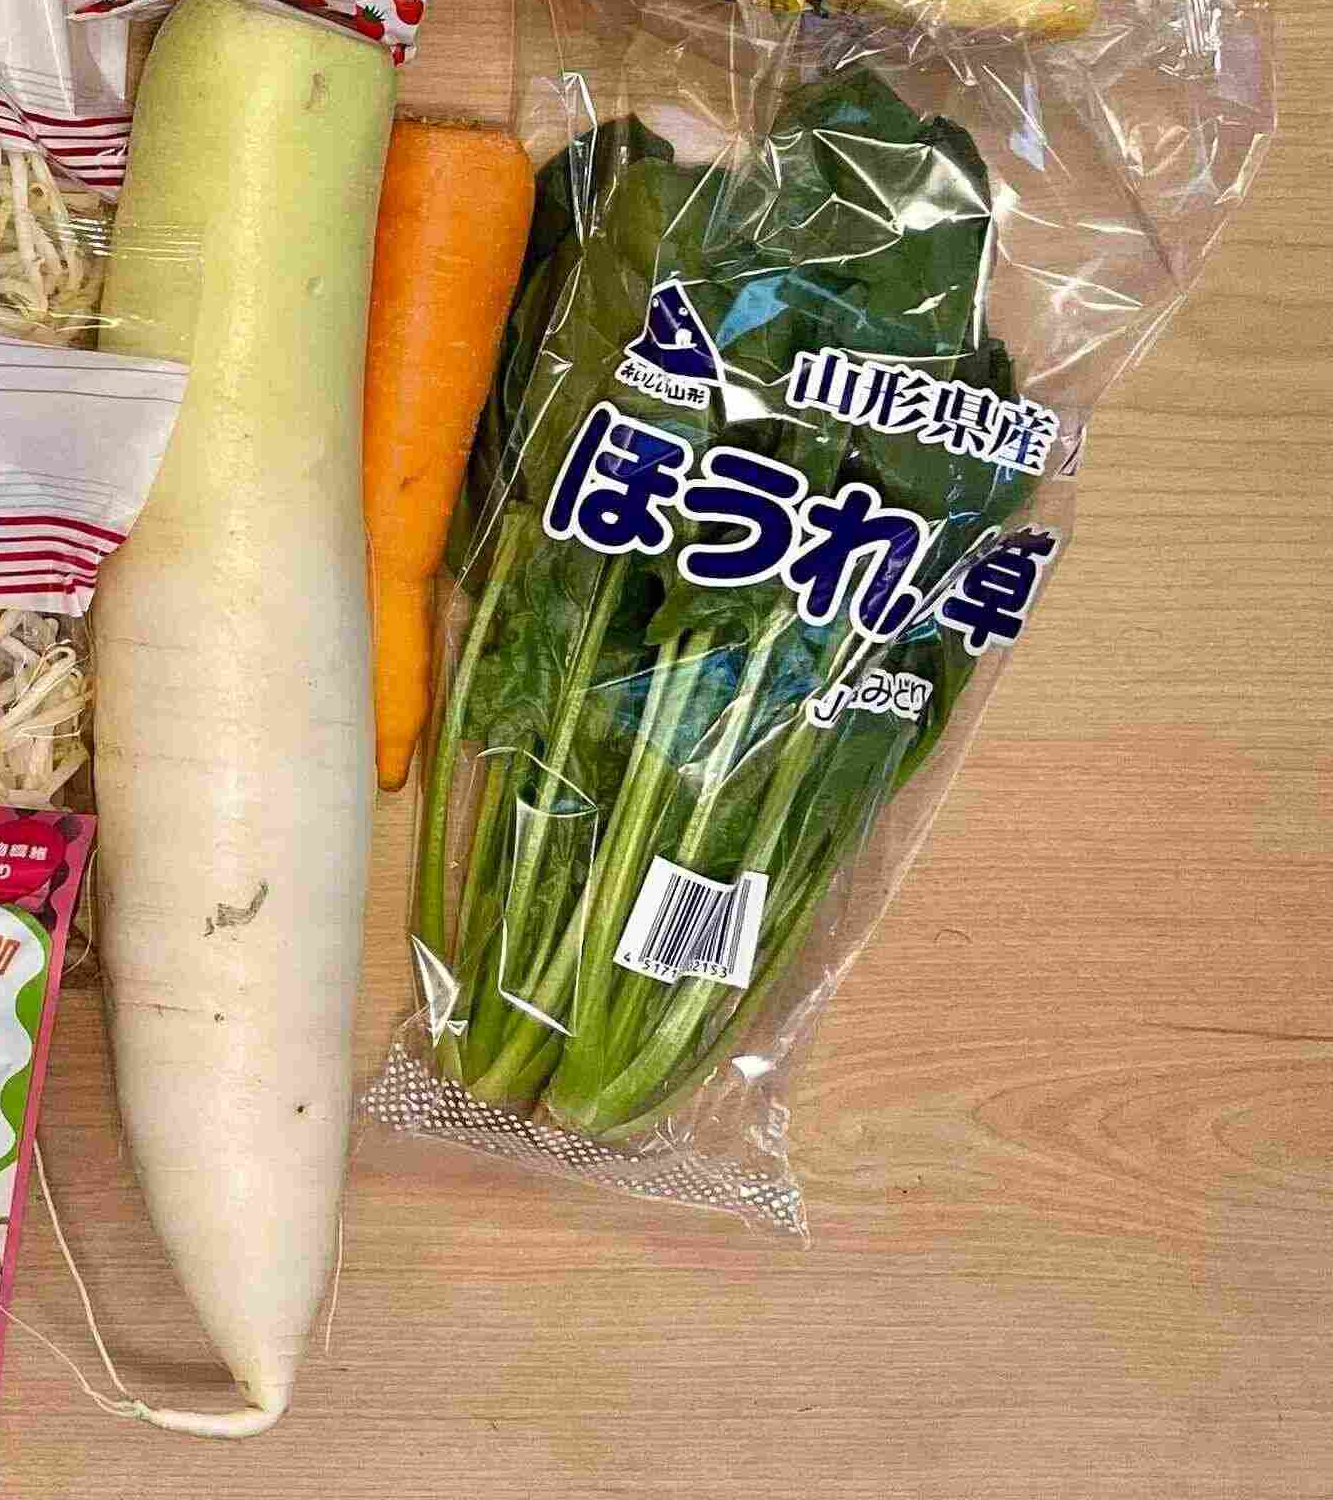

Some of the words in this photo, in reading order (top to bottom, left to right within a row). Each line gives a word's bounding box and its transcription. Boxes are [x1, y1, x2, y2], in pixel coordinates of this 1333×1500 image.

[621, 363, 706, 404] おいしい山形
[794, 353, 1053, 472] 山形県産
[549, 408, 1060, 648] ほうれ草
[813, 674, 927, 721] Jみどり
